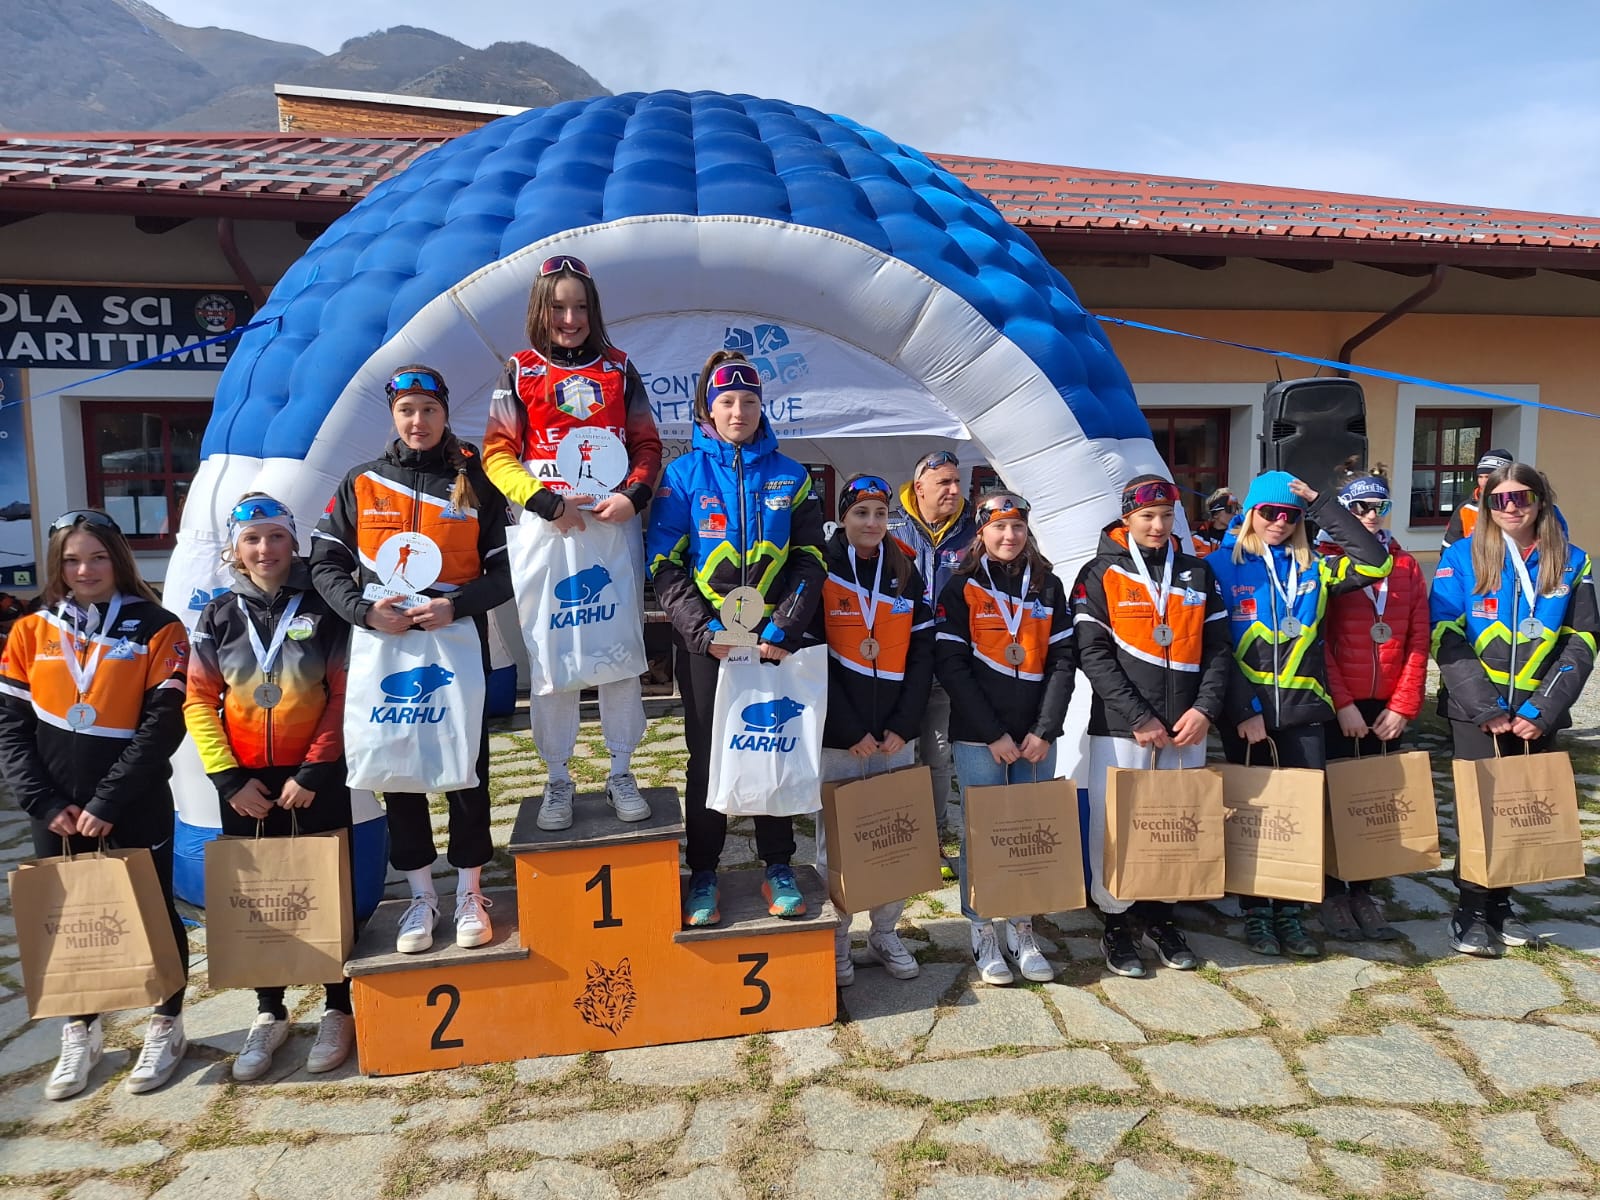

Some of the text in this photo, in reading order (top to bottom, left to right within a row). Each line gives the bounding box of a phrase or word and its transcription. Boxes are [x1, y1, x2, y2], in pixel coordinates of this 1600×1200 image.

[103, 296, 172, 326] SCI
[0, 331, 228, 364] ARITTIME
[550, 603, 616, 630] KARHU
[369, 706, 446, 724] KARHU
[729, 734, 797, 753] KARHU
[1347, 800, 1395, 817] Vecchio
[1491, 801, 1537, 817] Vecchio
[854, 820, 898, 842] Vecchio
[1133, 818, 1183, 831] Vecchio
[991, 831, 1038, 847] Vecchio
[228, 894, 290, 909] Vecchio
[585, 864, 623, 929] 1
[44, 918, 102, 936] Vecchio
[737, 952, 771, 1015] 3
[426, 984, 464, 1050] 2
